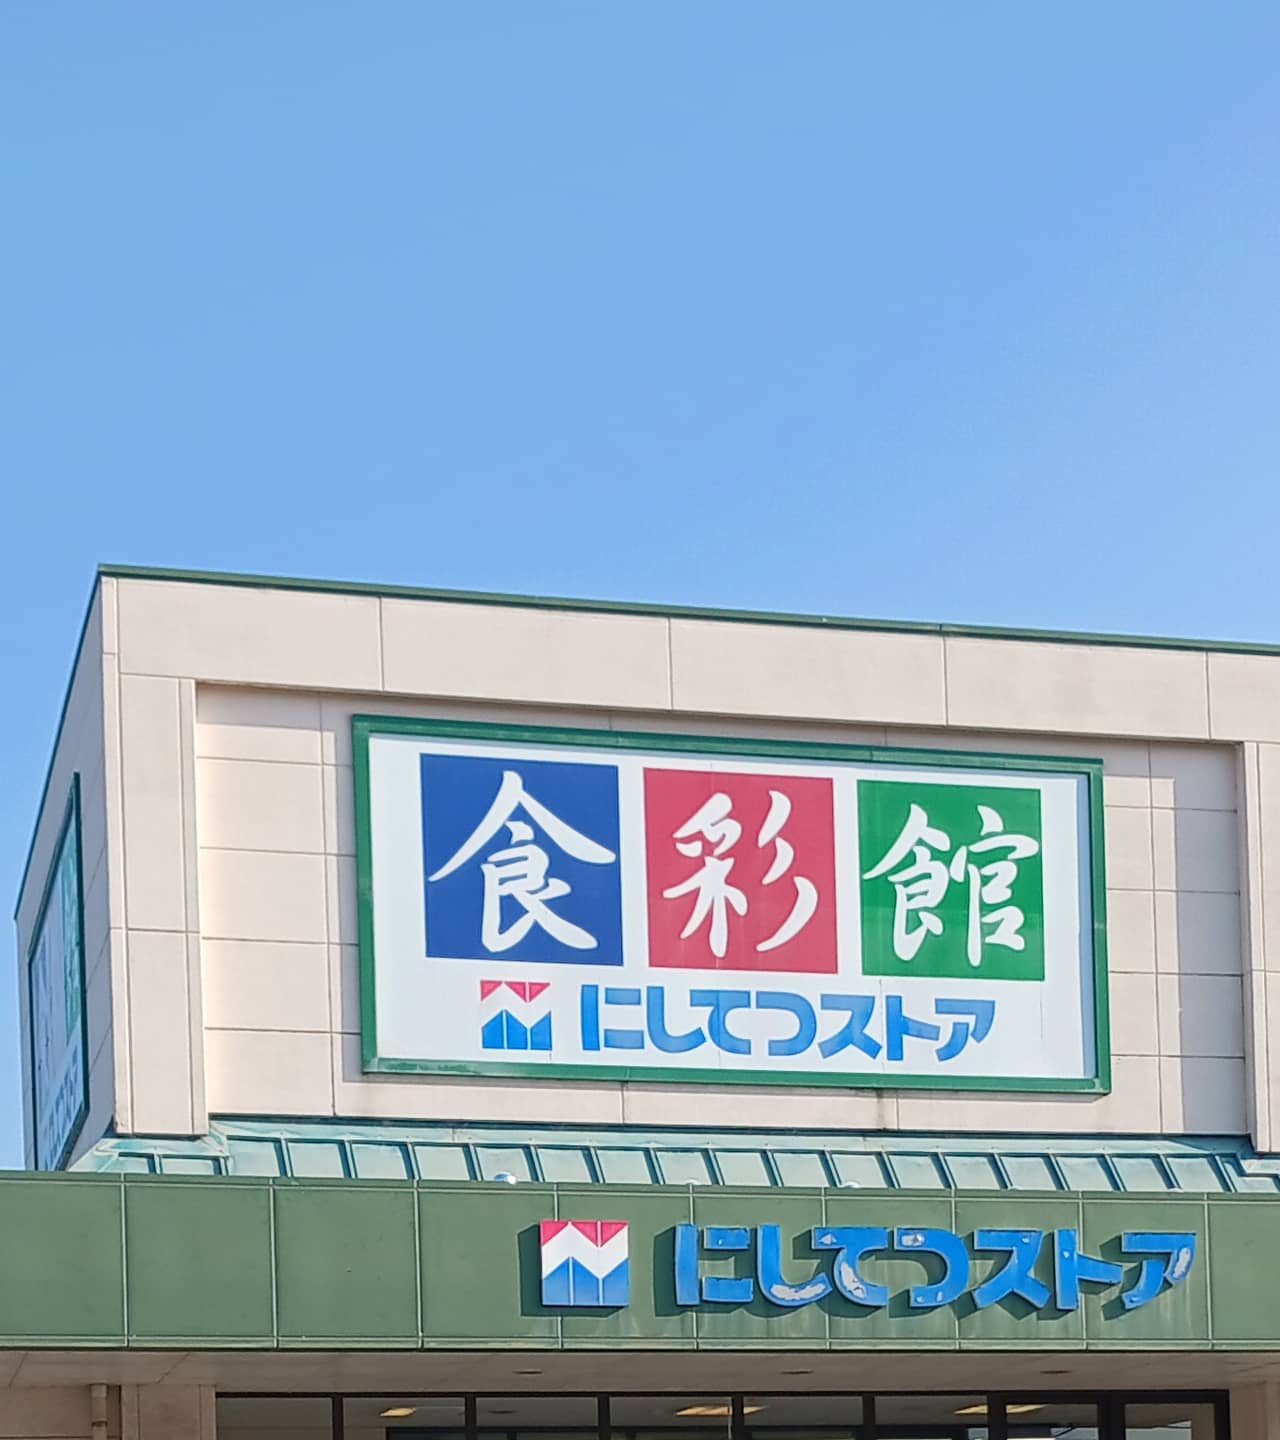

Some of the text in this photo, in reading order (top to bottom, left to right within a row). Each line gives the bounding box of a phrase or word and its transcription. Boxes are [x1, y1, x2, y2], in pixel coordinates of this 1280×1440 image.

[428, 769, 1041, 967] 食彩館
[580, 983, 996, 1062] にしてつストア
[674, 1222, 1197, 1310] にしてつストア
